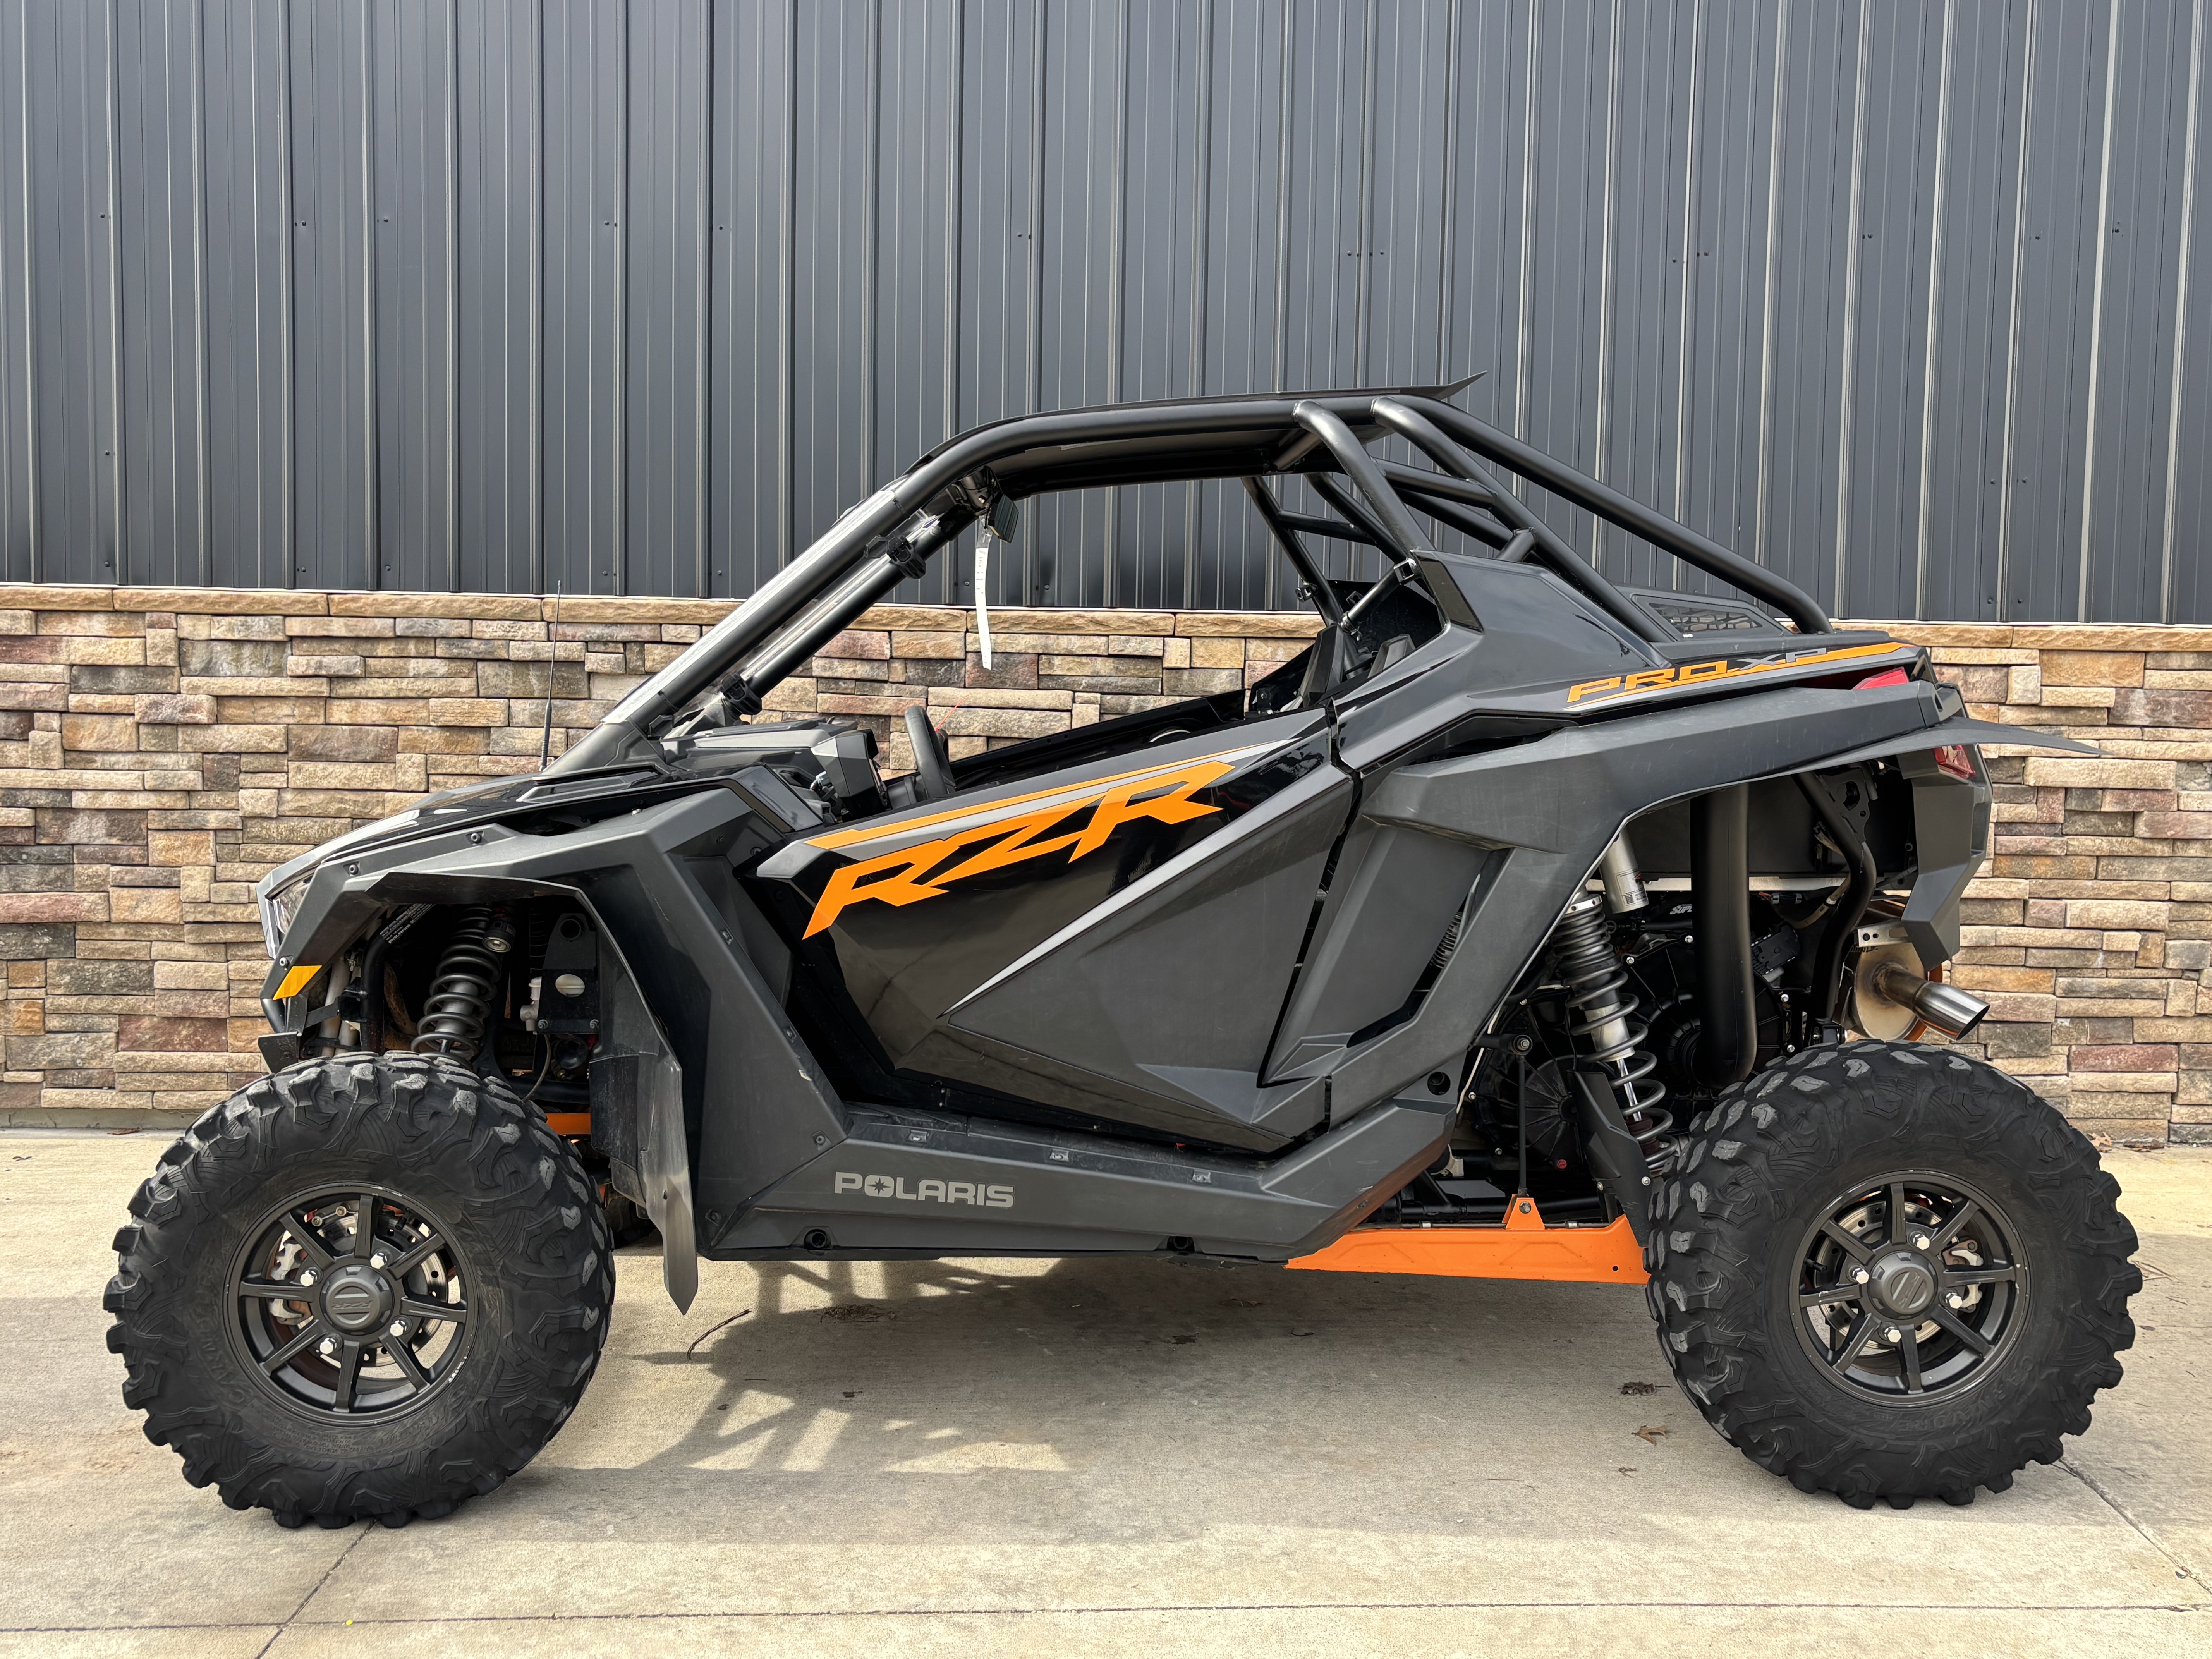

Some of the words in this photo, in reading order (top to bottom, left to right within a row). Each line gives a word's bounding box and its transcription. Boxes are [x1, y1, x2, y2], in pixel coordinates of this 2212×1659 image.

[1567, 660, 1728, 702] PRO
[1737, 647, 1827, 670] XP
[802, 761, 1235, 940] RZR
[834, 1172, 1015, 1208] POLARIS
